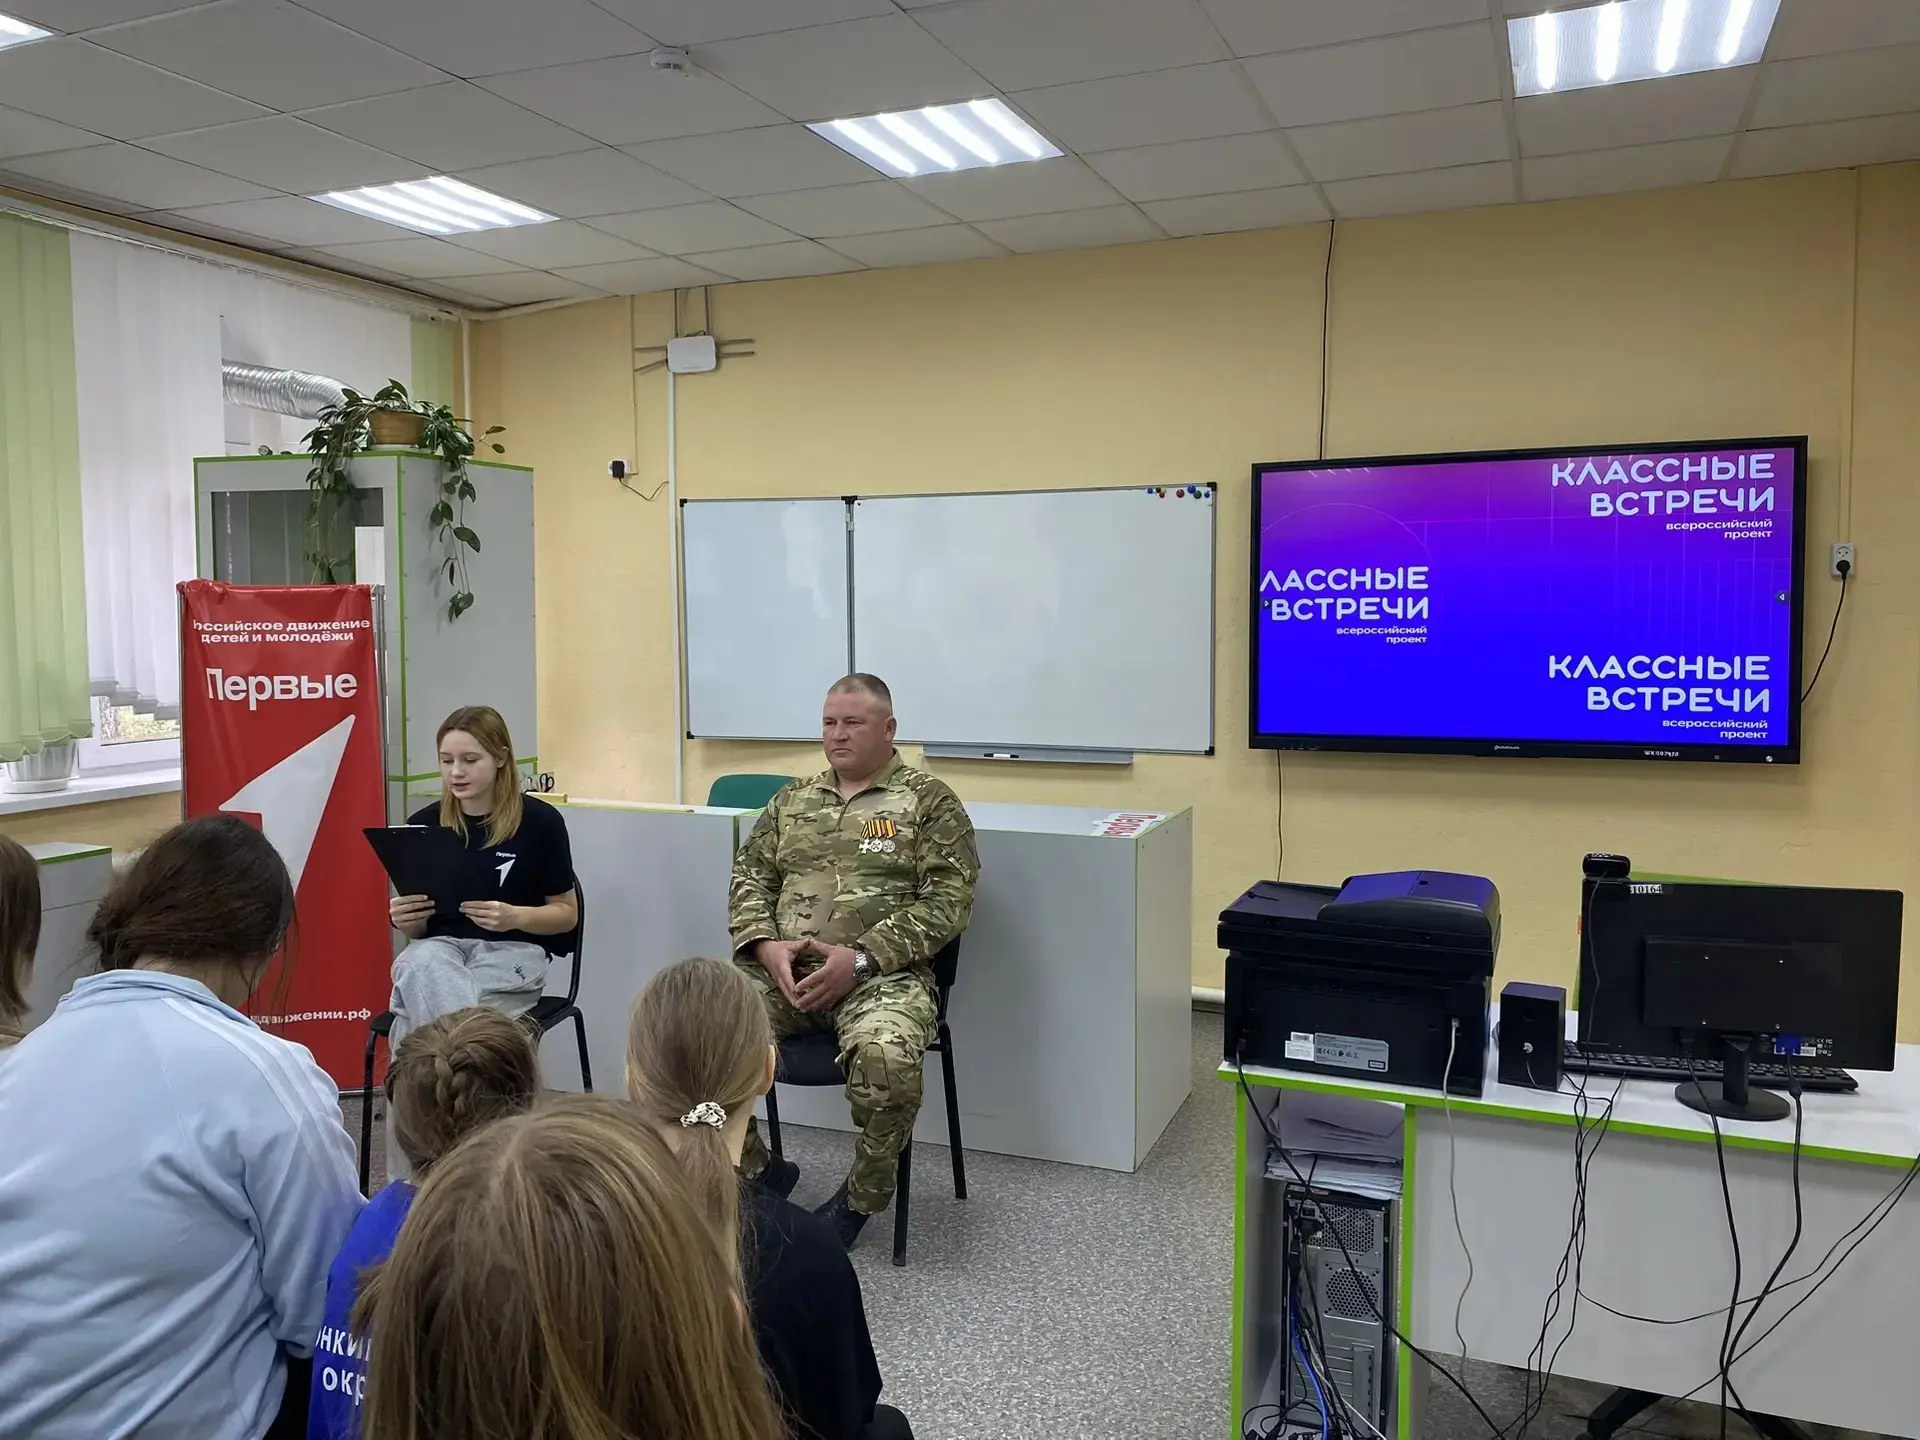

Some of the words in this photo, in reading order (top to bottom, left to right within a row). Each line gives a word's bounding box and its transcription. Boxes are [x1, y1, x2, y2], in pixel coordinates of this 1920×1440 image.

[1552, 453, 1775, 487] КЛАССНЫЕ
[1590, 486, 1775, 517] ВСТРЕЧИ
[1666, 518, 1773, 531] всероссийский
[1724, 530, 1773, 540] проект
[1260, 566, 1429, 592] ЛАССНЫЕ
[1271, 596, 1429, 621] ВСТРЕЧИ
[286, 619, 371, 632] движение
[1336, 626, 1428, 636] всероссийский
[201, 631, 249, 643] детей
[252, 633, 262, 642] и
[265, 631, 354, 643] молодёжи
[1386, 635, 1428, 645] проект
[1548, 655, 1771, 681] КЛАССНЫЕ
[206, 667, 358, 711] Первые
[1587, 686, 1770, 713] ВСТРЕЧИ
[1662, 719, 1768, 729] всероссийский
[1720, 731, 1768, 740] проект
